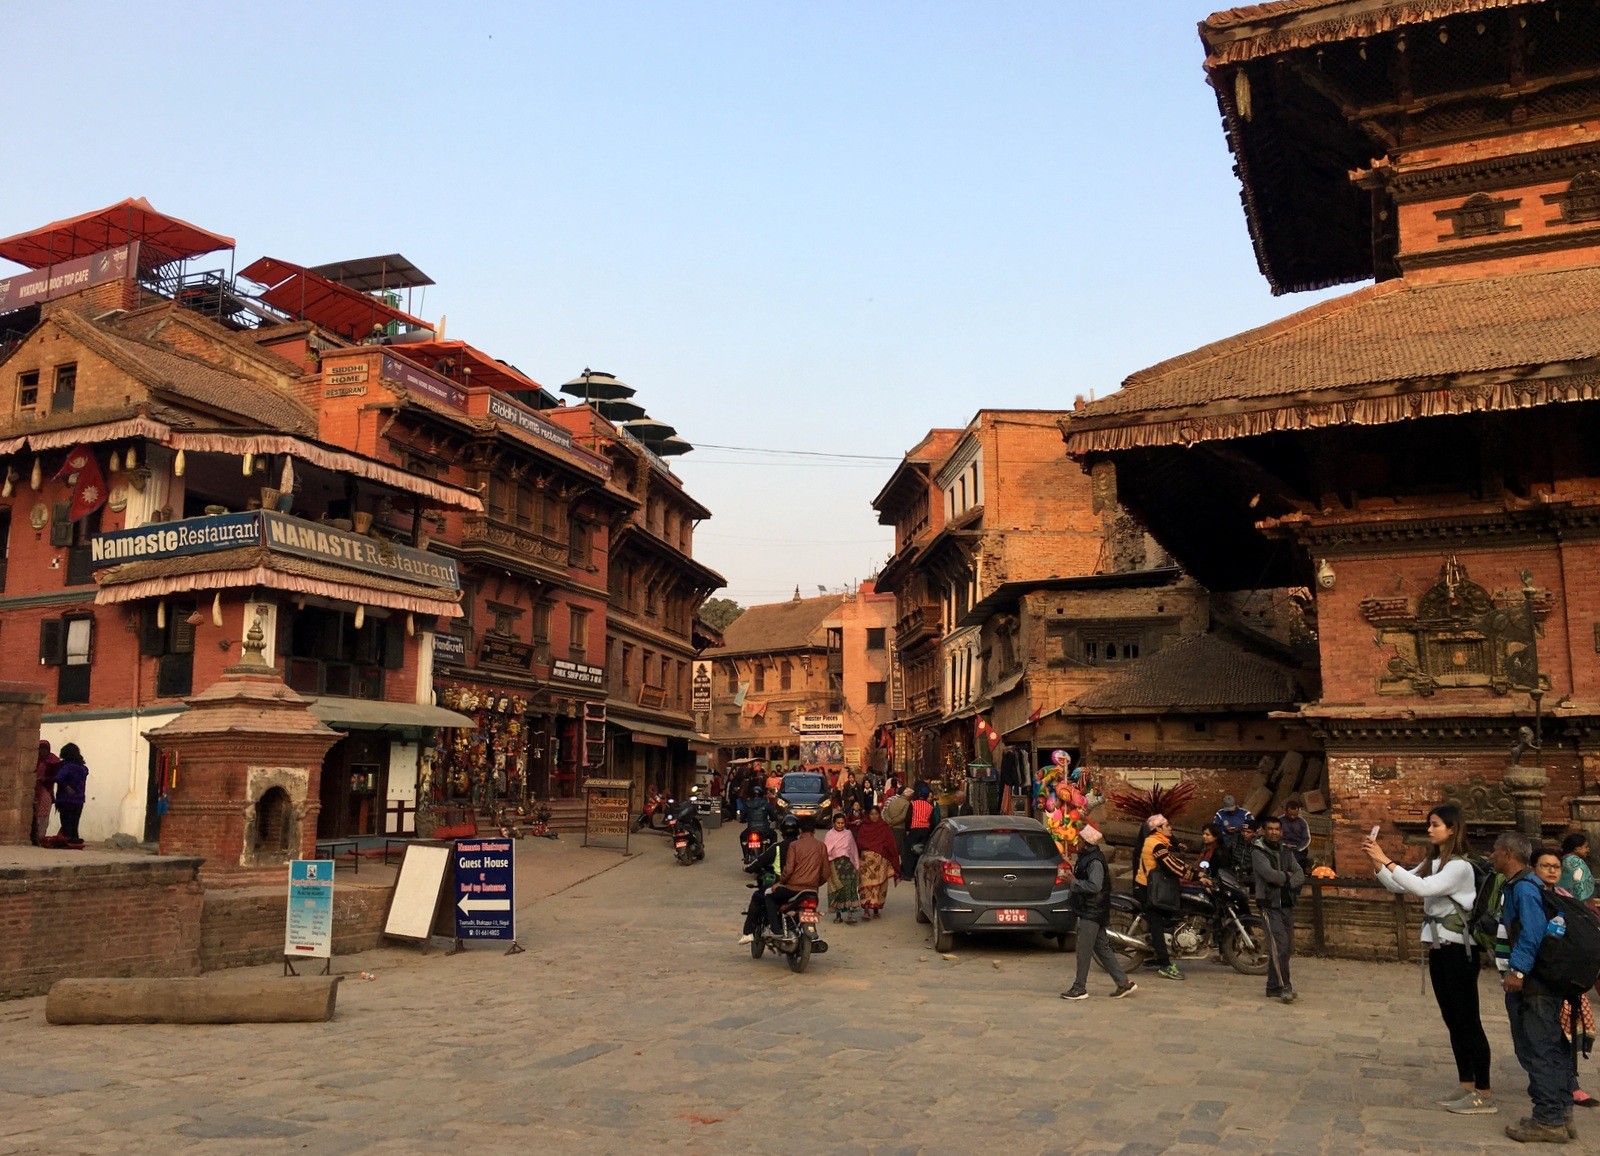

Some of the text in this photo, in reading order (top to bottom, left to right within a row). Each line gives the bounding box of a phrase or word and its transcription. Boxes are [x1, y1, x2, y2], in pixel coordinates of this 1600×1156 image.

[63, 272, 75, 287] TOP
[74, 269, 89, 284] CAFE
[331, 365, 363, 374] SIDDHI
[331, 375, 360, 384] HOME
[325, 386, 366, 396] RESTAURANT
[91, 521, 259, 562] Namaste Restaurant
[270, 519, 456, 582] NAMASTE Restaurant
[433, 637, 464, 654] Handicraft
[589, 812, 627, 820] RESTAURANT
[589, 826, 627, 834] GUEST HOUSE
[459, 857, 509, 868] Guest House
